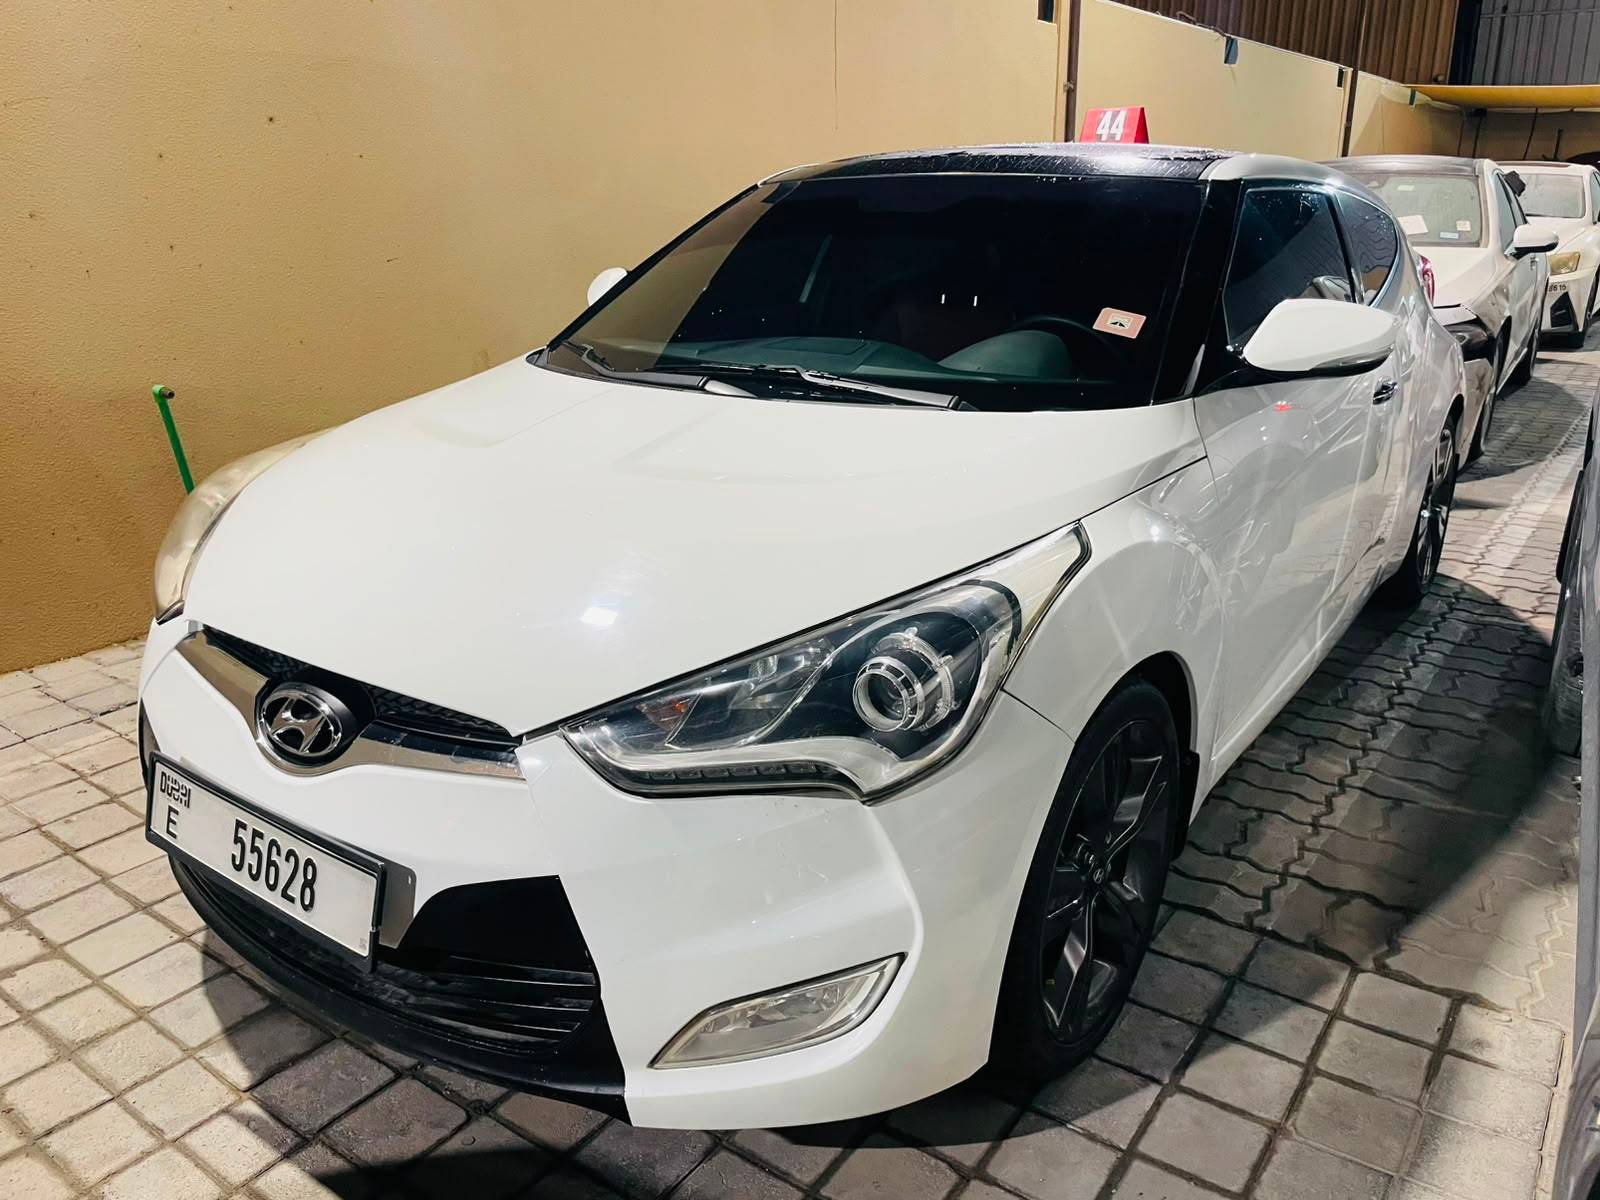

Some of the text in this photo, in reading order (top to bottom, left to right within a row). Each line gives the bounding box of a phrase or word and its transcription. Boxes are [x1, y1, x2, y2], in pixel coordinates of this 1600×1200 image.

[1096, 111, 1127, 141] 44
[166, 805, 179, 839] E
[231, 818, 317, 912] 55628
